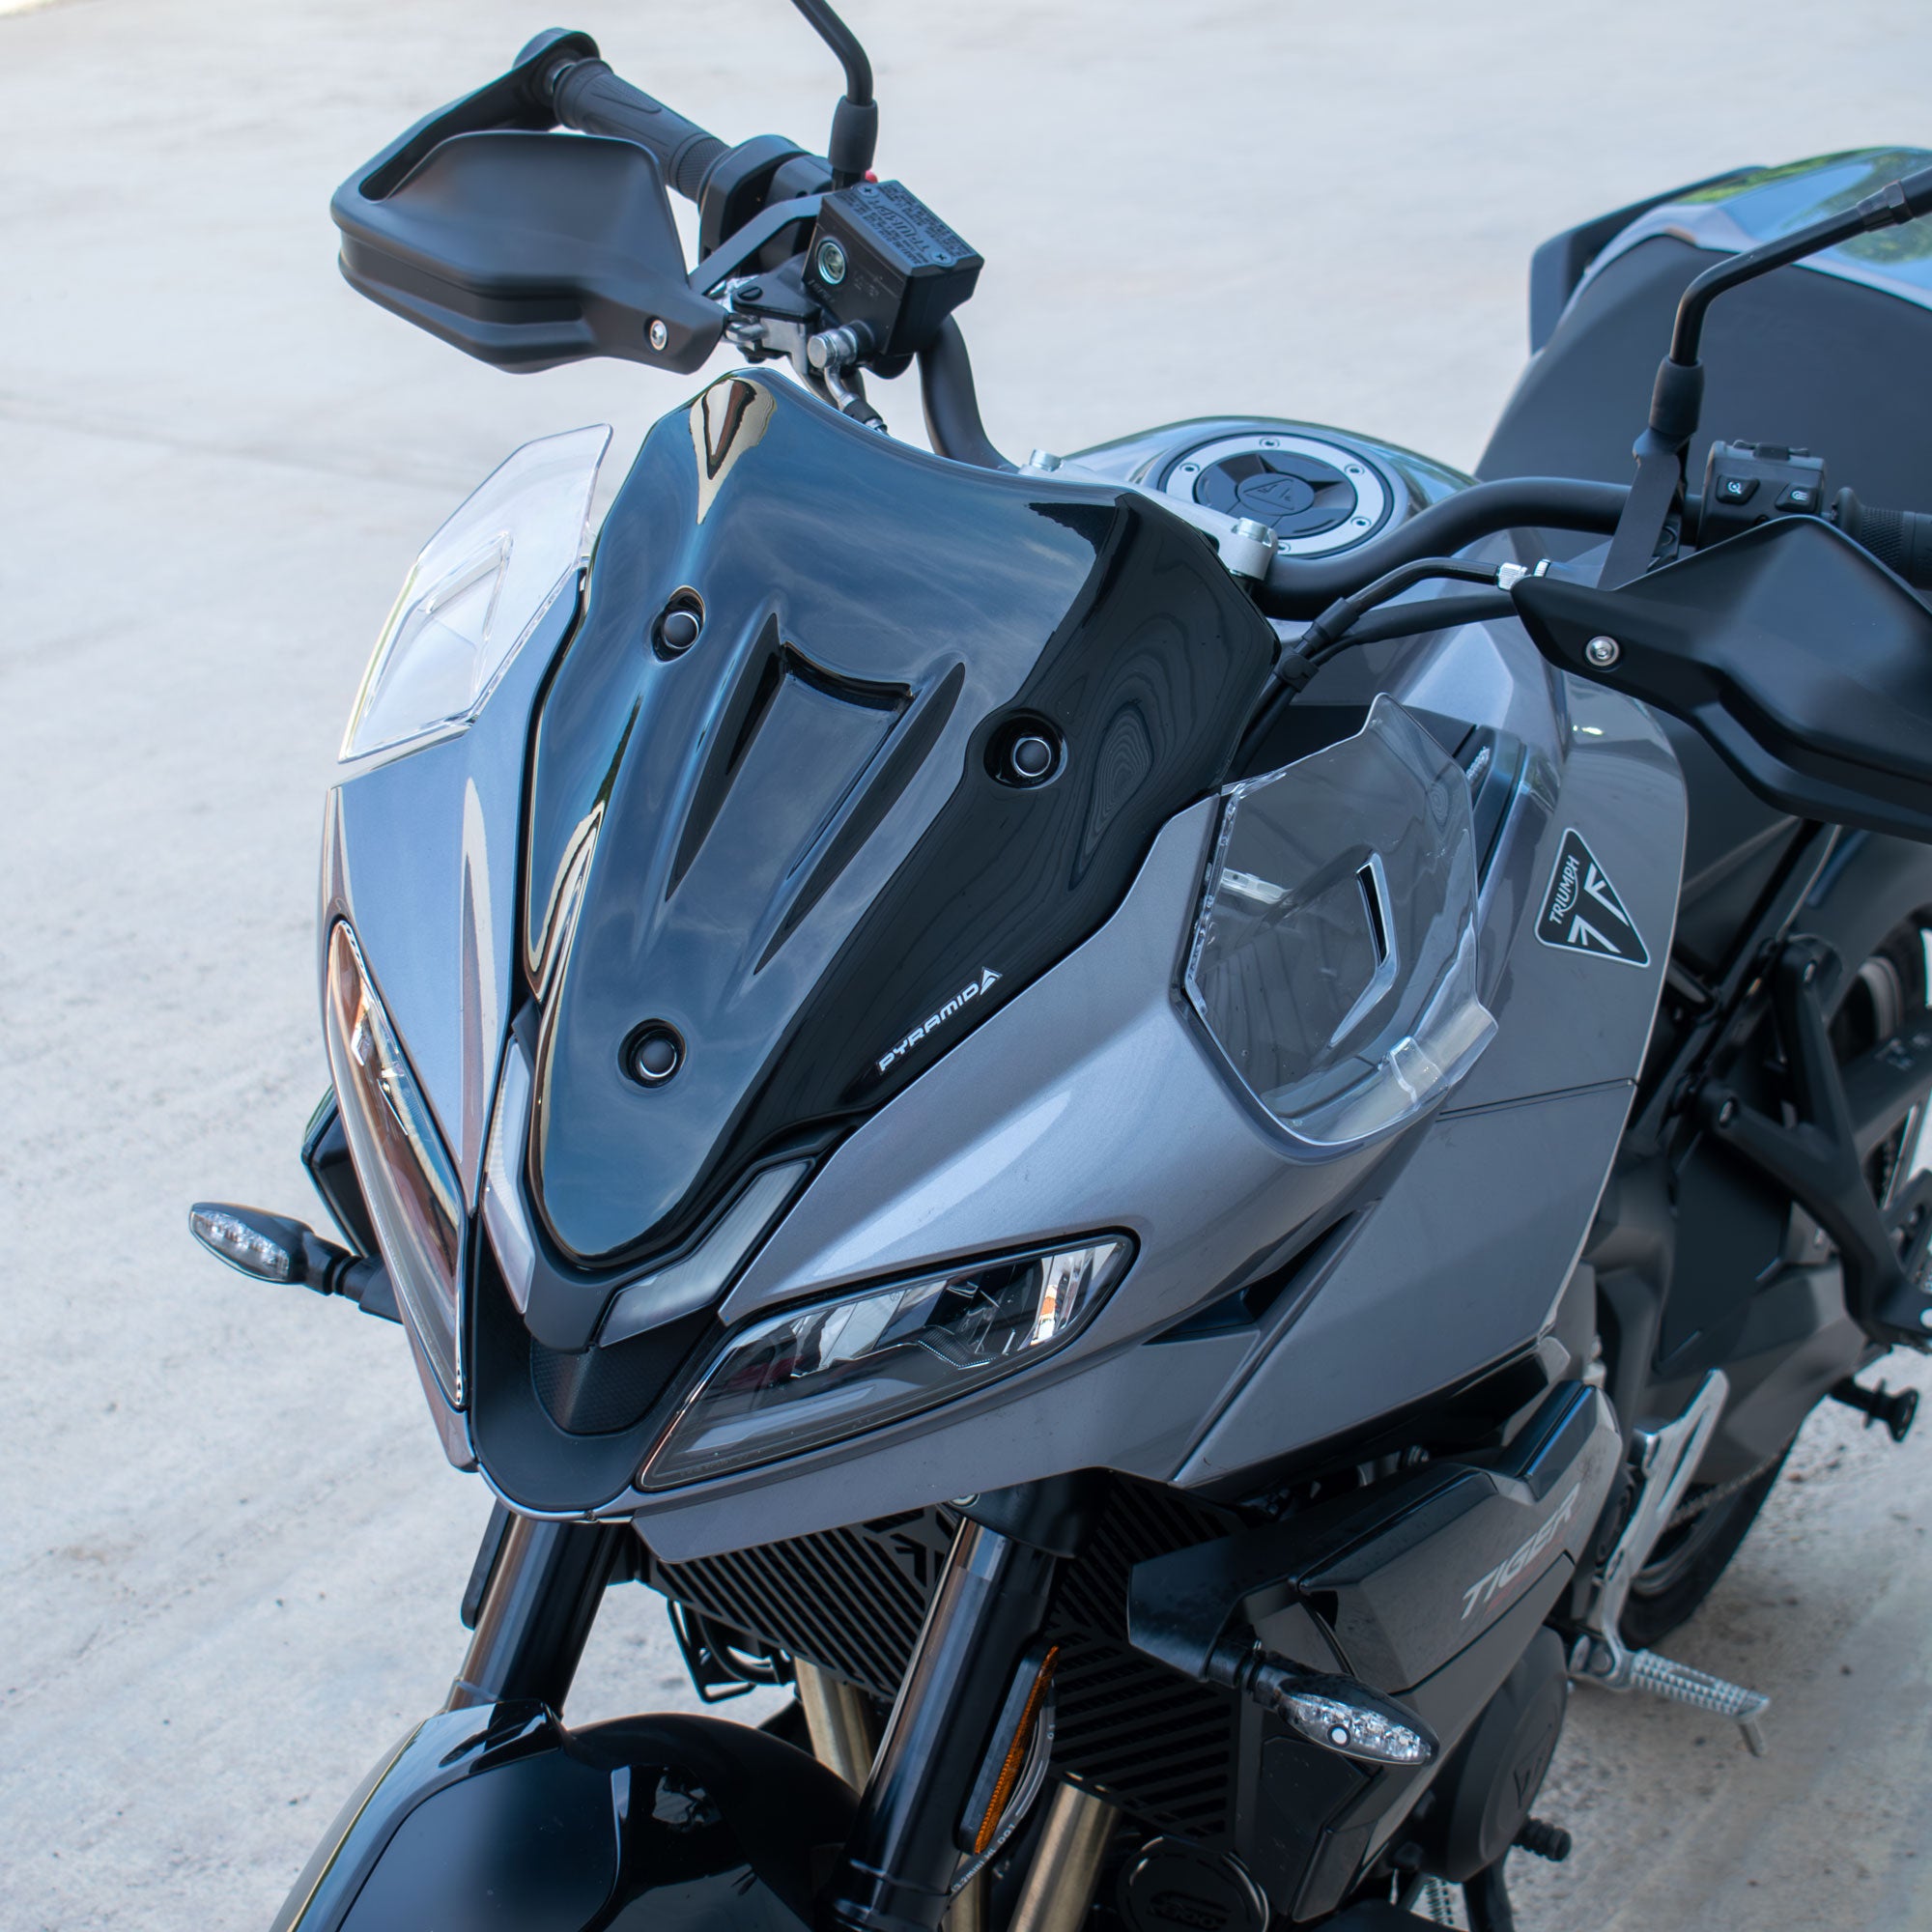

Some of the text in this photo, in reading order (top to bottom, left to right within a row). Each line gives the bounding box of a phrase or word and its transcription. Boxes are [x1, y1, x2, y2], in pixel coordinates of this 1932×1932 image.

[867, 199, 930, 252] TRIUMPH
[1548, 854, 1580, 925] TRIUMPH
[878, 981, 980, 1072] PYRAMID
[1461, 1481, 1580, 1621] TIGER
